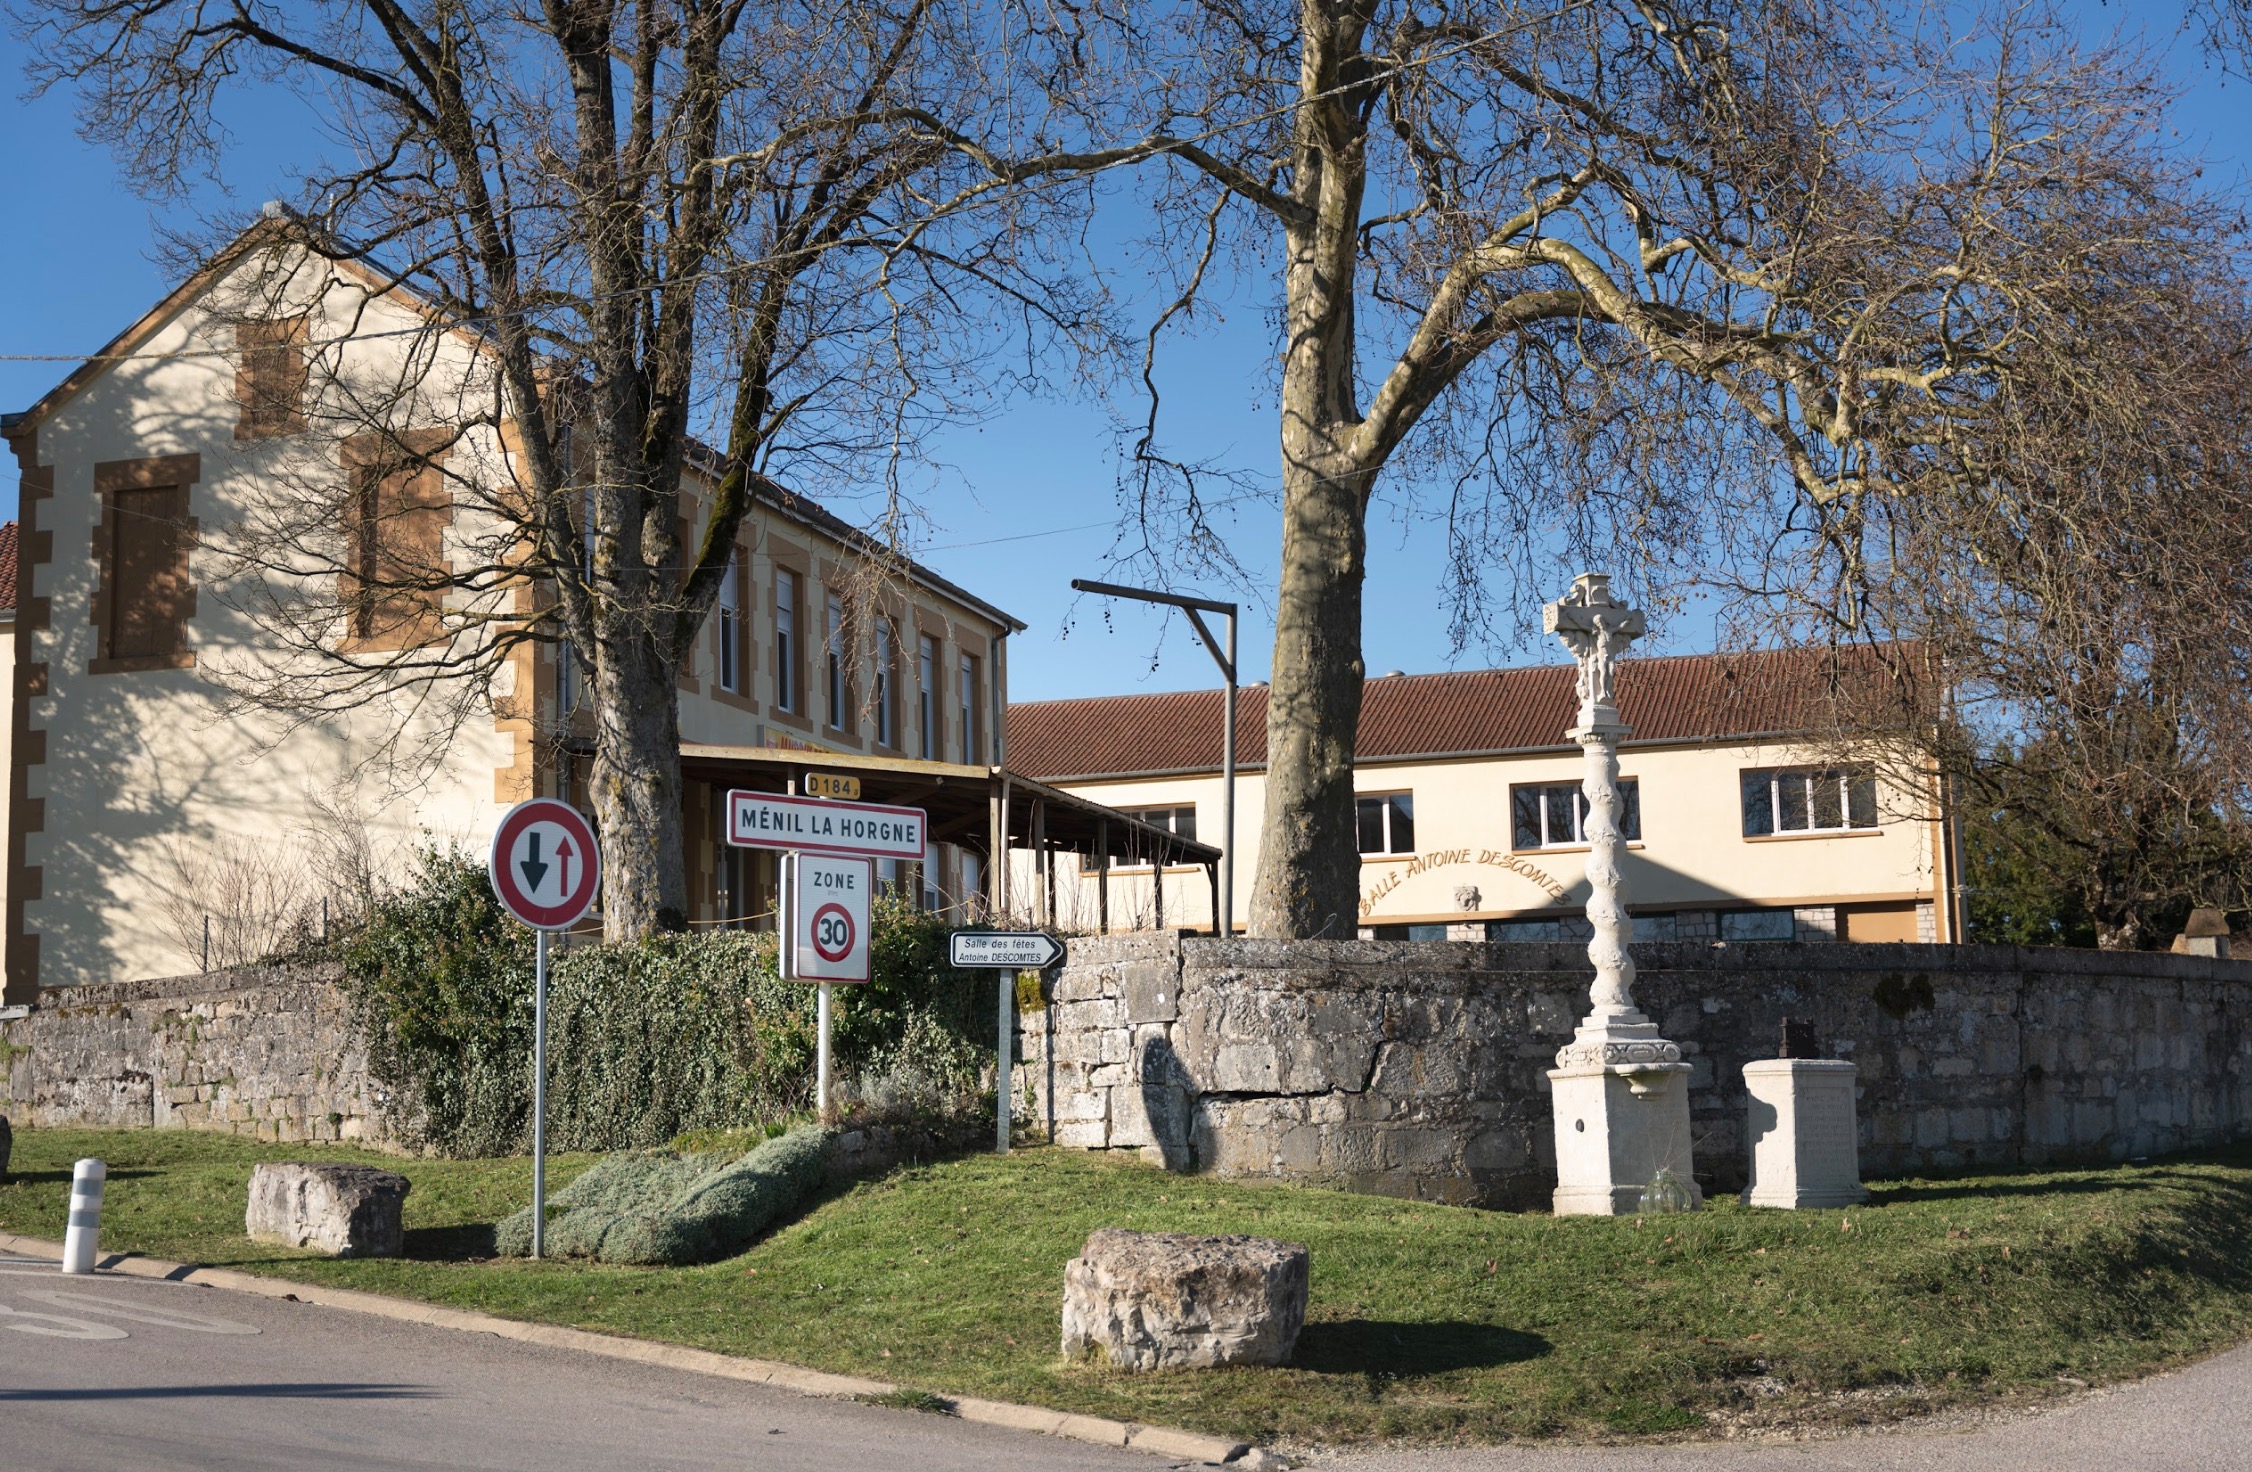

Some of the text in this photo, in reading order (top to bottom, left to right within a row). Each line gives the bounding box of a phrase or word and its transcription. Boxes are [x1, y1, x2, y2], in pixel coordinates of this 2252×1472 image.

[810, 777, 818, 791] D
[742, 807, 915, 843] MÉNIL LA HORGNE
[814, 871, 854, 889] ZONE
[1359, 848, 1572, 917] SALLE ANTOINE DESCOMTES
[819, 918, 847, 946] 30
[964, 938, 1036, 949] Salle des fêtes
[959, 952, 1042, 962] Antoine DESCOMTES
